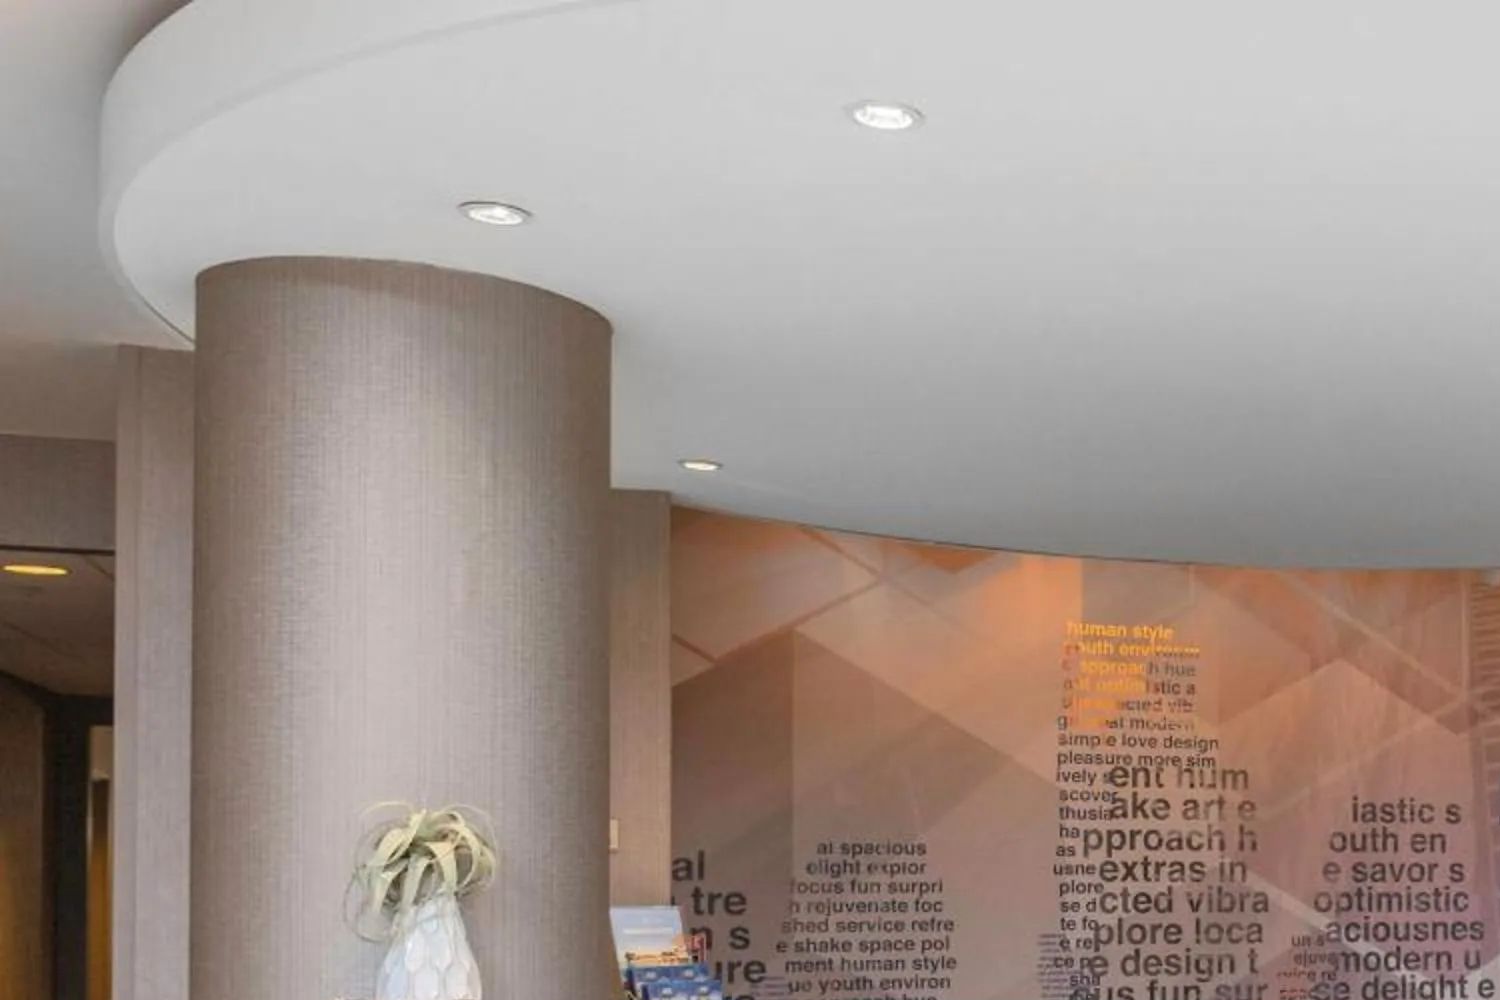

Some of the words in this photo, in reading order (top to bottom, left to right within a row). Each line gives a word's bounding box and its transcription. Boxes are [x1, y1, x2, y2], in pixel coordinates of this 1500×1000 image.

[1133, 624, 1175, 641] style
[1121, 734, 1157, 748] love
[1163, 735, 1219, 752] design
[1057, 751, 1132, 767] pleasure
[1138, 754, 1181, 767] more
[1056, 769, 1097, 785] ively
[1111, 791, 1171, 821] ake
[1352, 794, 1435, 825] iastic
[1445, 802, 1462, 825] s
[1083, 824, 1226, 858] pproach
[1329, 826, 1398, 853] outh
[1410, 832, 1447, 854] en
[1099, 856, 1206, 882] extras
[1219, 856, 1248, 882] in
[1352, 861, 1439, 883] savor
[1448, 861, 1465, 883] s
[850, 878, 881, 894] fun
[692, 886, 748, 917] tre
[807, 898, 909, 916] rejuvenate
[1099, 886, 1174, 914] cted
[1187, 886, 1269, 914] vibra
[1313, 886, 1469, 918] optimistic
[729, 924, 752, 951] s
[781, 917, 829, 934] shed
[835, 917, 906, 933] service
[1094, 917, 1182, 951] plore
[1195, 918, 1264, 944] loca
[1325, 916, 1485, 943] aciousnes
[794, 937, 853, 953] shake
[859, 937, 916, 955] space
[921, 936, 950, 953] pol
[785, 958, 834, 974] ment
[840, 956, 906, 972] human
[911, 955, 957, 974] style
[1121, 948, 1235, 983] design
[1336, 946, 1452, 973] modern
[819, 977, 873, 995] youth
[879, 974, 951, 991] environ
[1477, 978, 1495, 999] e
